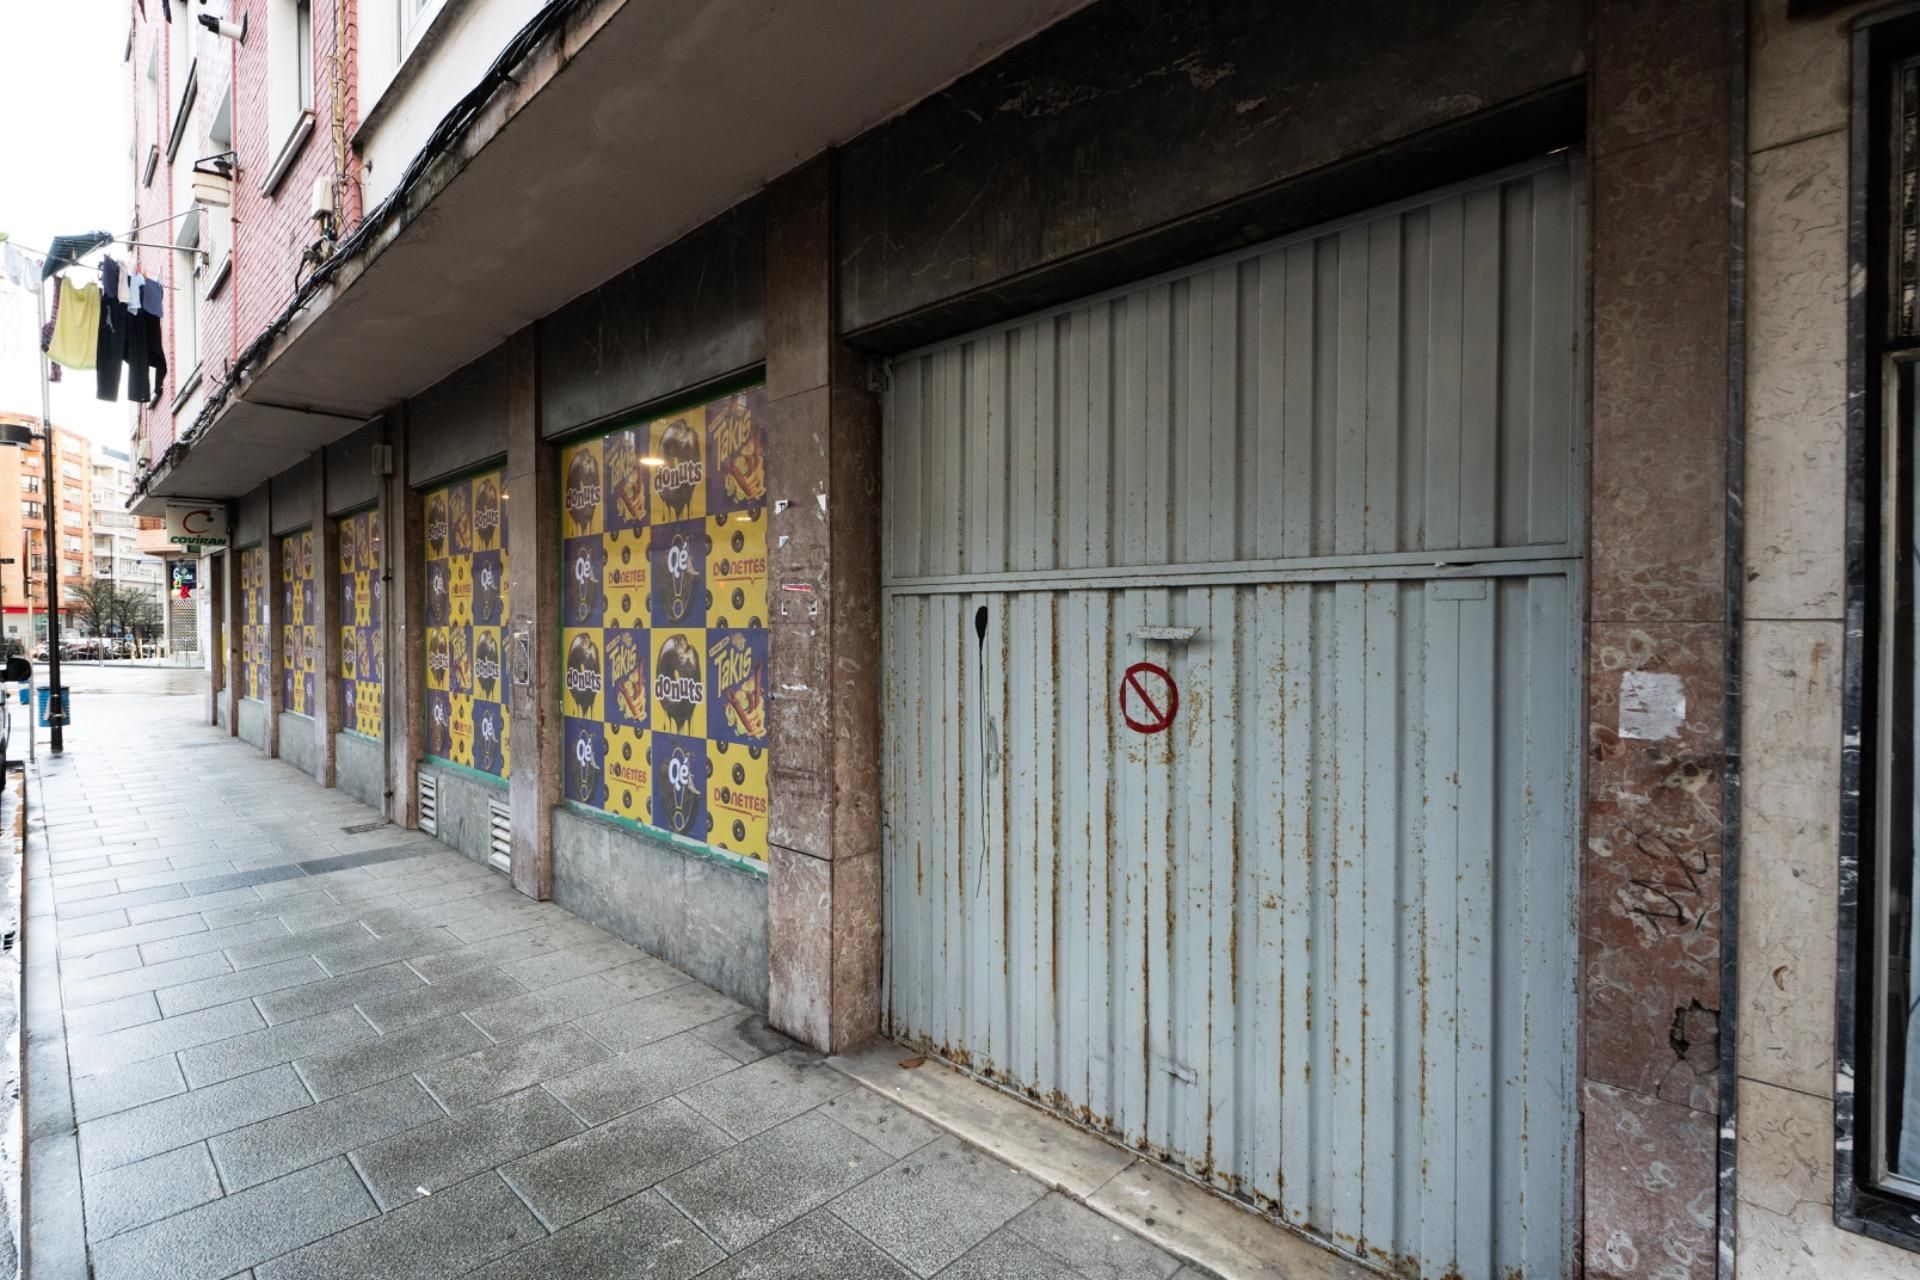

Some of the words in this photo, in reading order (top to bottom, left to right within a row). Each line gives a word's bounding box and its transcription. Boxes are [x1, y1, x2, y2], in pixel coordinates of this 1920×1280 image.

[654, 460, 702, 493] donuts
[566, 484, 601, 511] donuts
[575, 554, 591, 584] Qé
[668, 541, 688, 578] Qé
[567, 668, 601, 692] donuts
[655, 674, 704, 704] donuts
[576, 738, 592, 767] Qé
[668, 755, 689, 791] Qé
